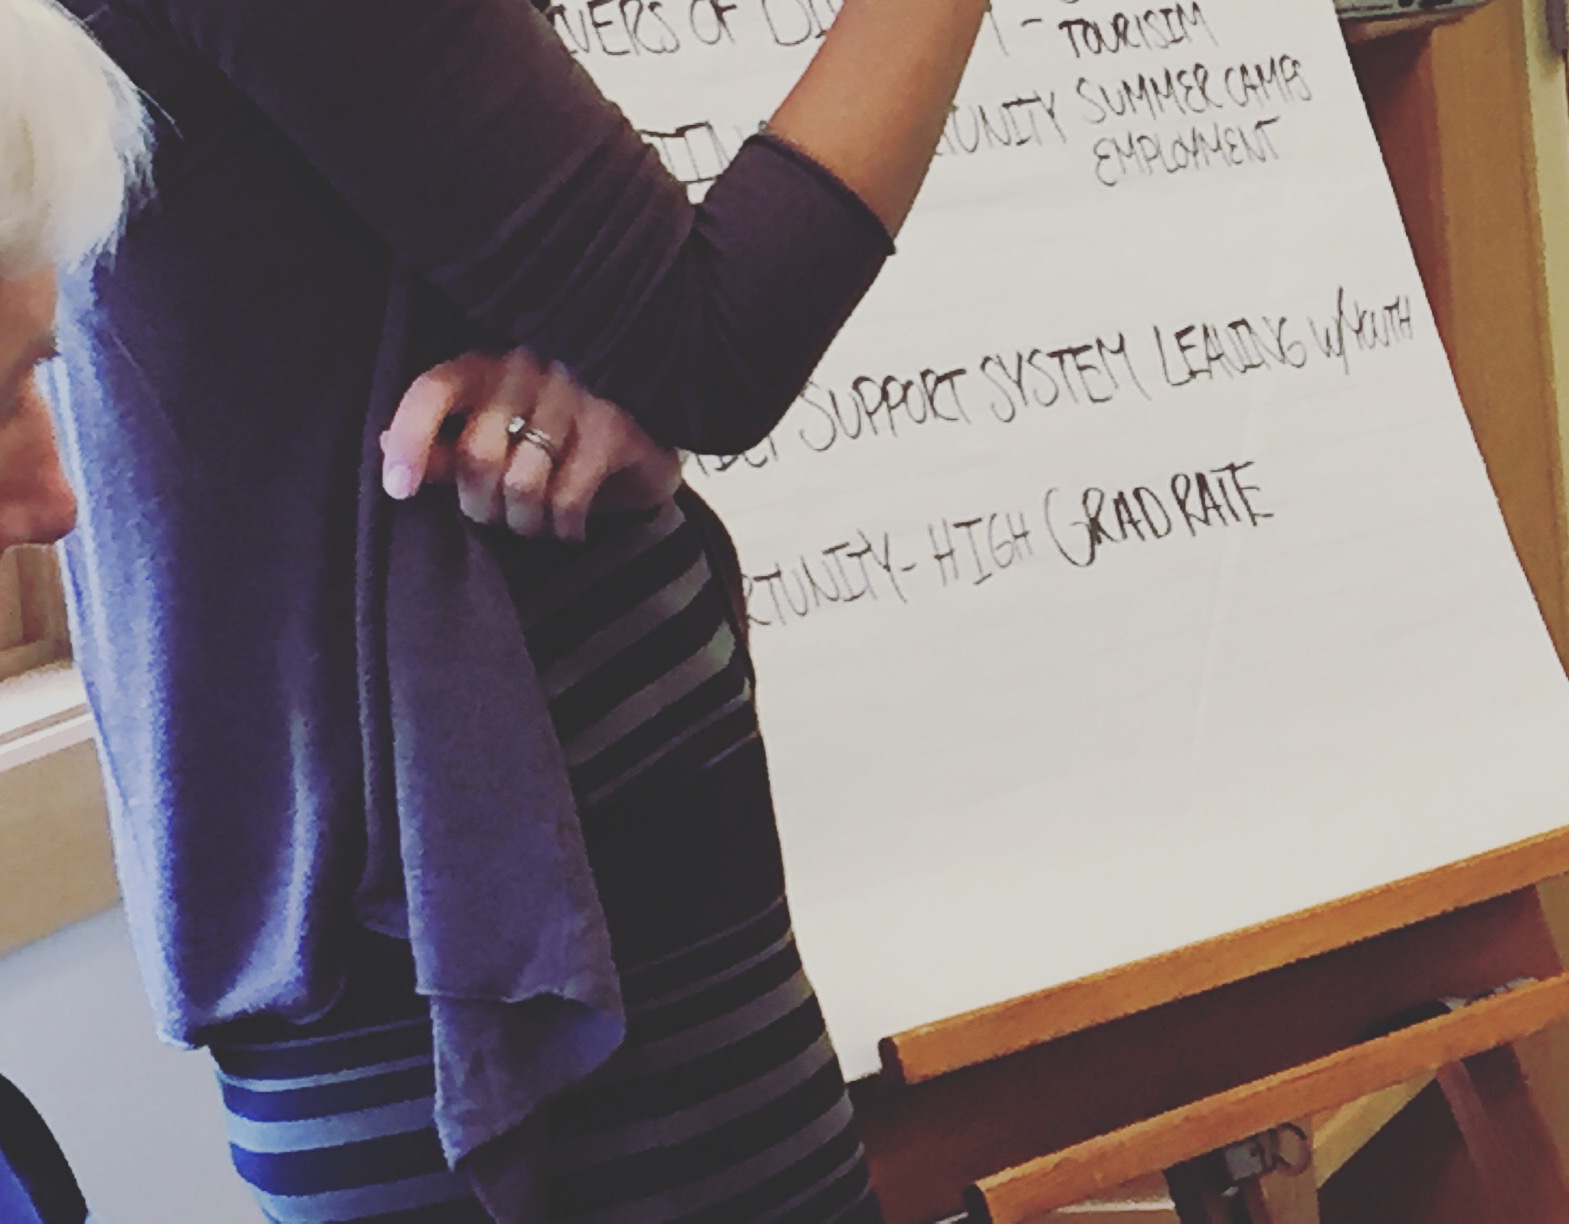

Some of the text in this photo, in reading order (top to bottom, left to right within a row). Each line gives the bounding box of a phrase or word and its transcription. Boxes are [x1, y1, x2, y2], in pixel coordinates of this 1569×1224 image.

[936, 89, 1069, 157] UNITY
[1076, 62, 1224, 124] SUMMER
[799, 368, 972, 454] SUPPORT
[979, 330, 1152, 424] SYSTEM
[927, 510, 1032, 587] HIGH
